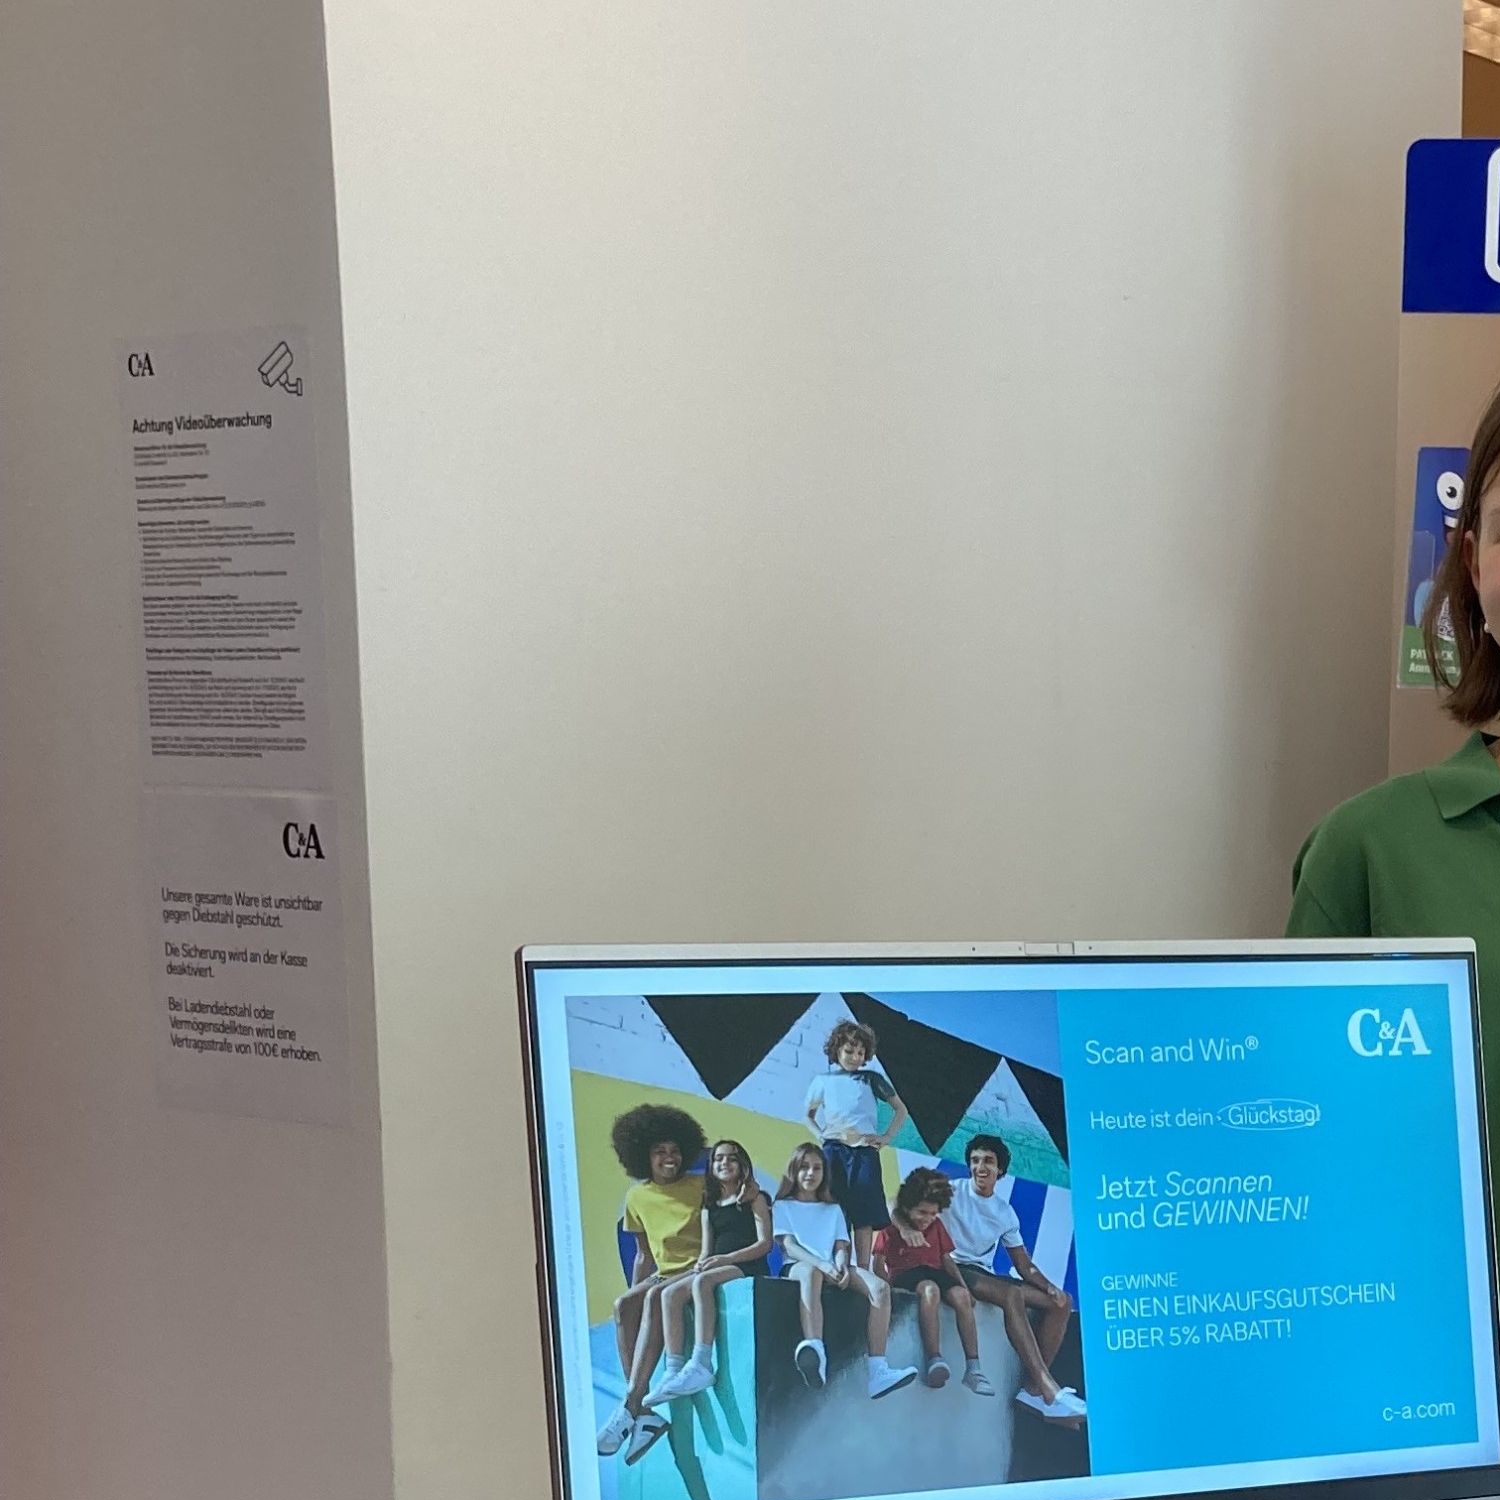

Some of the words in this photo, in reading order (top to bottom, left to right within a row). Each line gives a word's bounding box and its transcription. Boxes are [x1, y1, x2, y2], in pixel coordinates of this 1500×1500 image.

[128, 353, 155, 378] C&A
[132, 417, 173, 435] Achtung
[175, 412, 272, 431] Videoüberwachung
[282, 822, 325, 859] C&A
[161, 886, 192, 904] Unsere
[194, 892, 233, 906] gesamte
[234, 892, 260, 907] Ware
[261, 894, 273, 908] ist
[274, 895, 323, 912] unsichtbar
[162, 908, 191, 924] gegen
[192, 907, 234, 924] Diebstahl
[235, 912, 283, 929] geschützt.
[165, 942, 180, 957] Die
[181, 943, 227, 964] Sicherung
[228, 948, 248, 963] wird
[249, 952, 261, 964] an
[263, 950, 279, 965] der
[280, 951, 308, 967] Kasse
[166, 961, 215, 978] deaktiviert.
[168, 996, 183, 1012] Bei
[184, 998, 252, 1017] Ladendiebstahl
[253, 1005, 275, 1020] oder
[169, 1015, 254, 1036] Vermögensdelikten
[255, 1024, 275, 1039] wird
[277, 1028, 296, 1042] eine
[1347, 1008, 1431, 1057] C&A
[170, 1033, 233, 1053] Vertragsstrafe
[234, 1044, 251, 1055] von
[253, 1041, 279, 1058] 100€
[281, 1045, 322, 1063] erhoben.
[1086, 1040, 1144, 1064] Scan
[1151, 1038, 1193, 1063] and
[1090, 1110, 1146, 1130] Heute
[1150, 1108, 1170, 1128] ist
[1176, 1107, 1214, 1127] dein
[1097, 1174, 1156, 1200] Jetzt
[1164, 1172, 1272, 1198] Scannen
[1098, 1206, 1145, 1231] und
[1153, 1195, 1309, 1229] GEWINNEN!
[1101, 1272, 1178, 1291] GEWINNE
[1104, 1297, 1168, 1320] EINEN
[1174, 1282, 1395, 1316] EINKAUFSGUTSCHEIN
[1106, 1325, 1164, 1351] ÜBER
[1169, 1325, 1200, 1346] 5%
[1205, 1318, 1291, 1344] RABATT!
[1382, 1402, 1456, 1422] c-a.com
